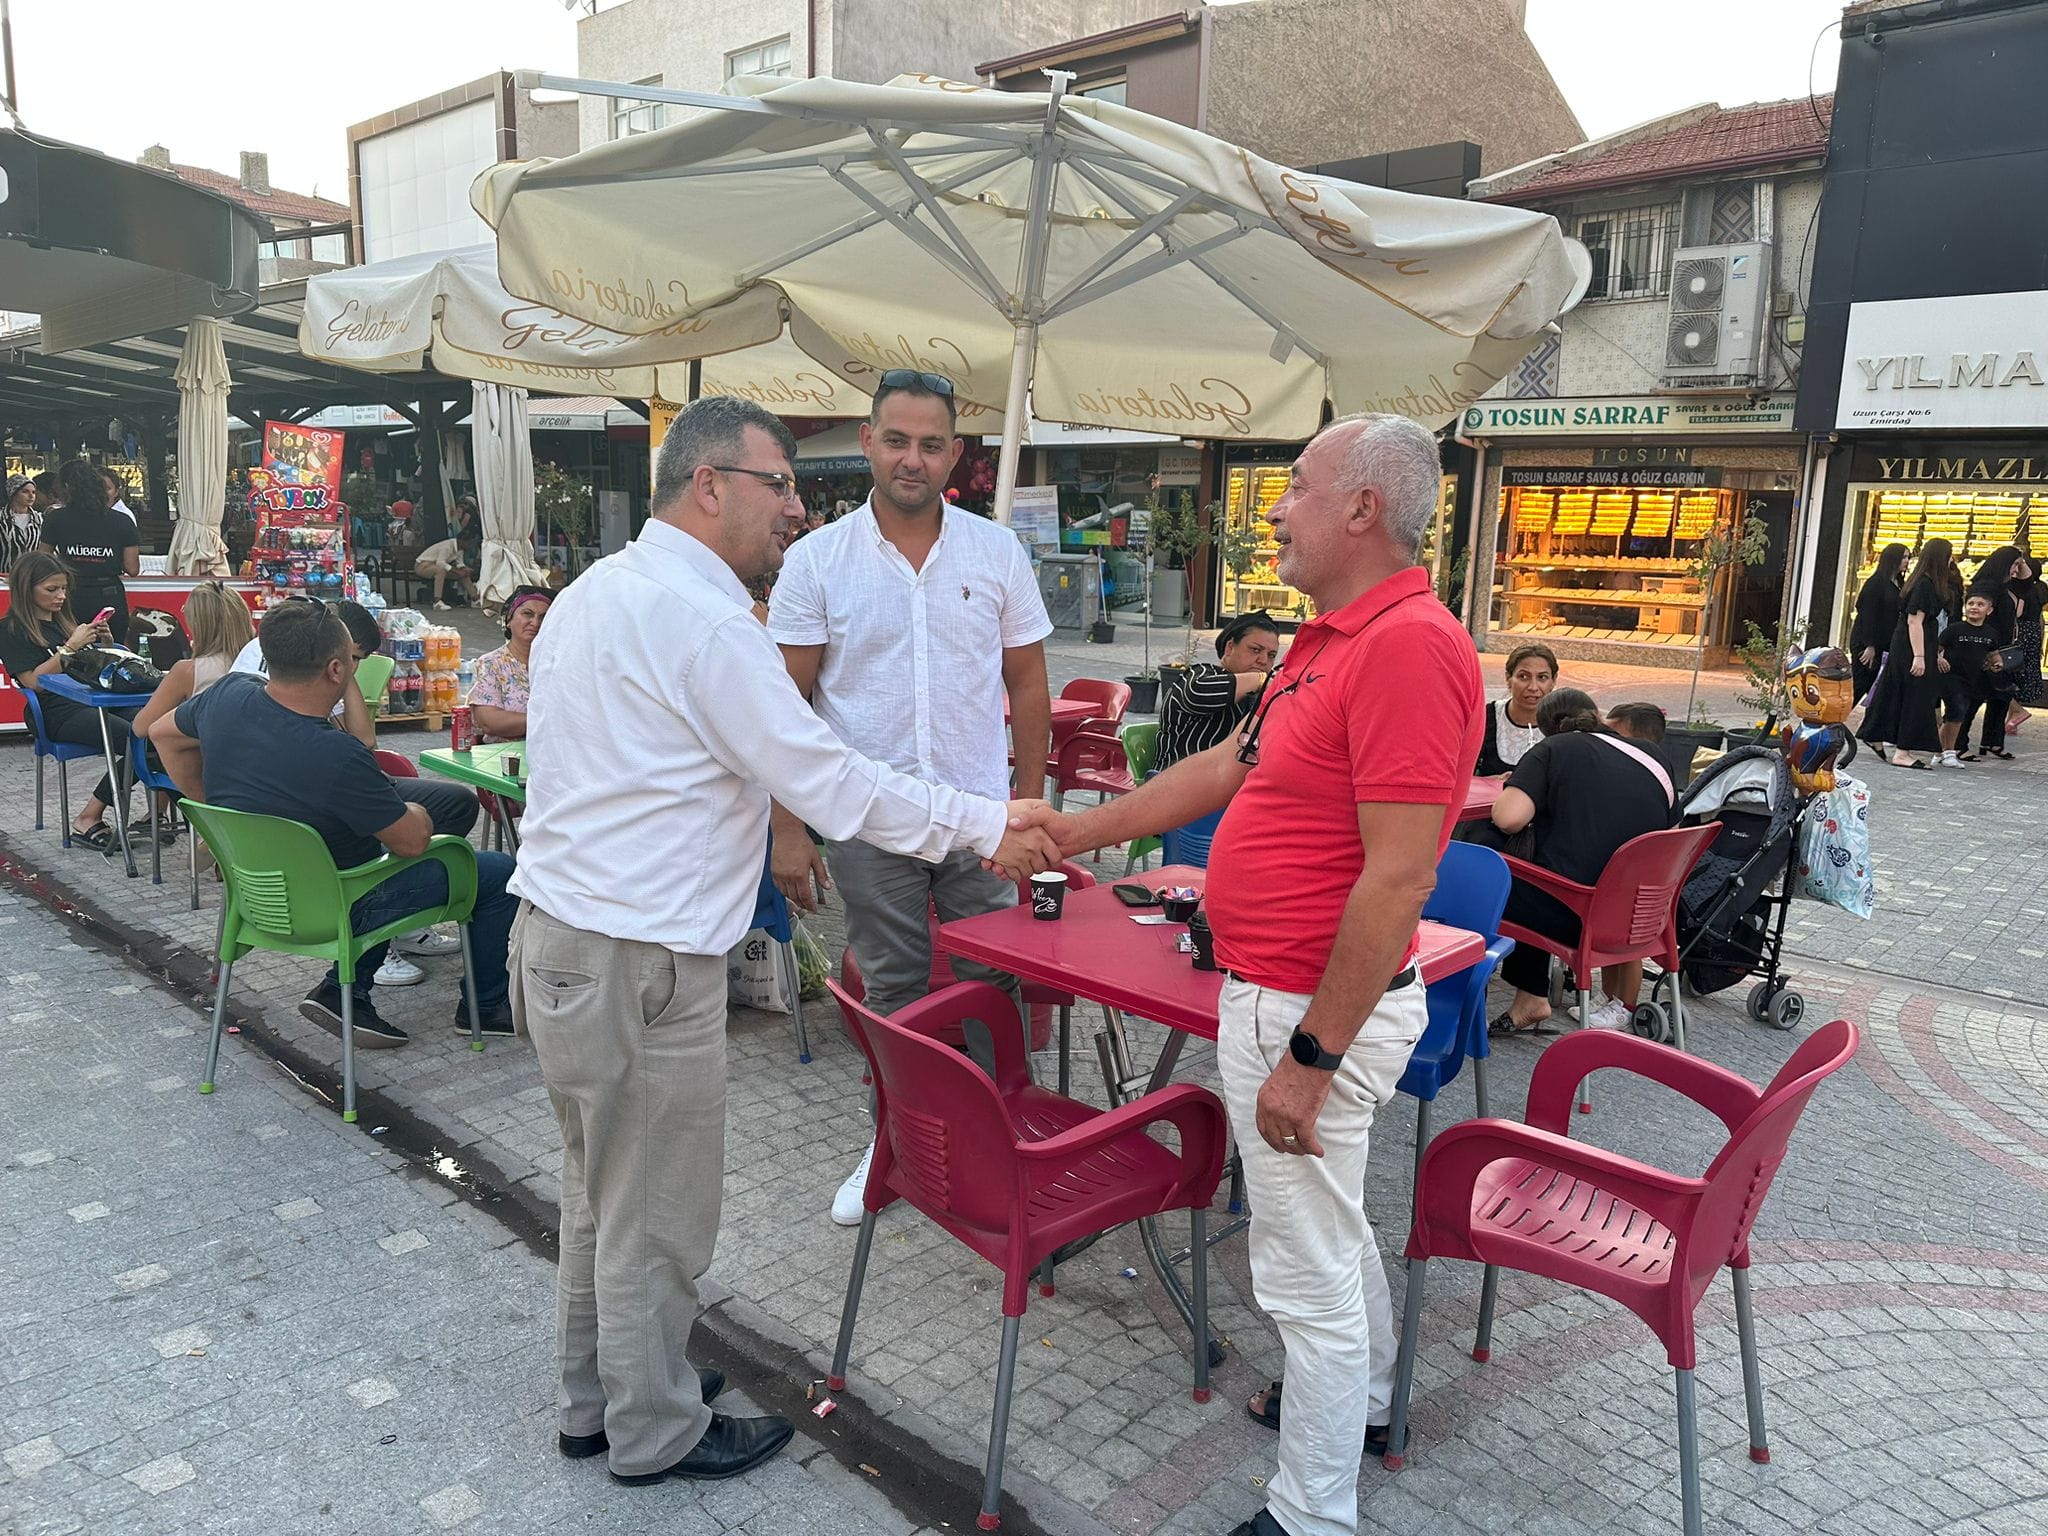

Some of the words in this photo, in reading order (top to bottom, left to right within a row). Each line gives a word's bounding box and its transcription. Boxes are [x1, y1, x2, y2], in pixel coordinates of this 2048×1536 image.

[1488, 408, 1567, 427] TOSUN
[1572, 405, 1670, 425] SARRAF
[1712, 404, 1721, 412] &
[1879, 409, 1905, 417] Çarşı
[1600, 447, 1687, 463] TOSUN
[1877, 457, 2048, 480] YILMAZL
[1511, 471, 1544, 483] TOSUN
[1545, 471, 1585, 483] SARRAF
[1586, 471, 1619, 486] SAVAŞ
[1621, 471, 1629, 484] &
[1631, 469, 1662, 484] OĞUZ
[1663, 472, 1705, 485] GARKIN
[67, 544, 114, 557] MÜBREM
